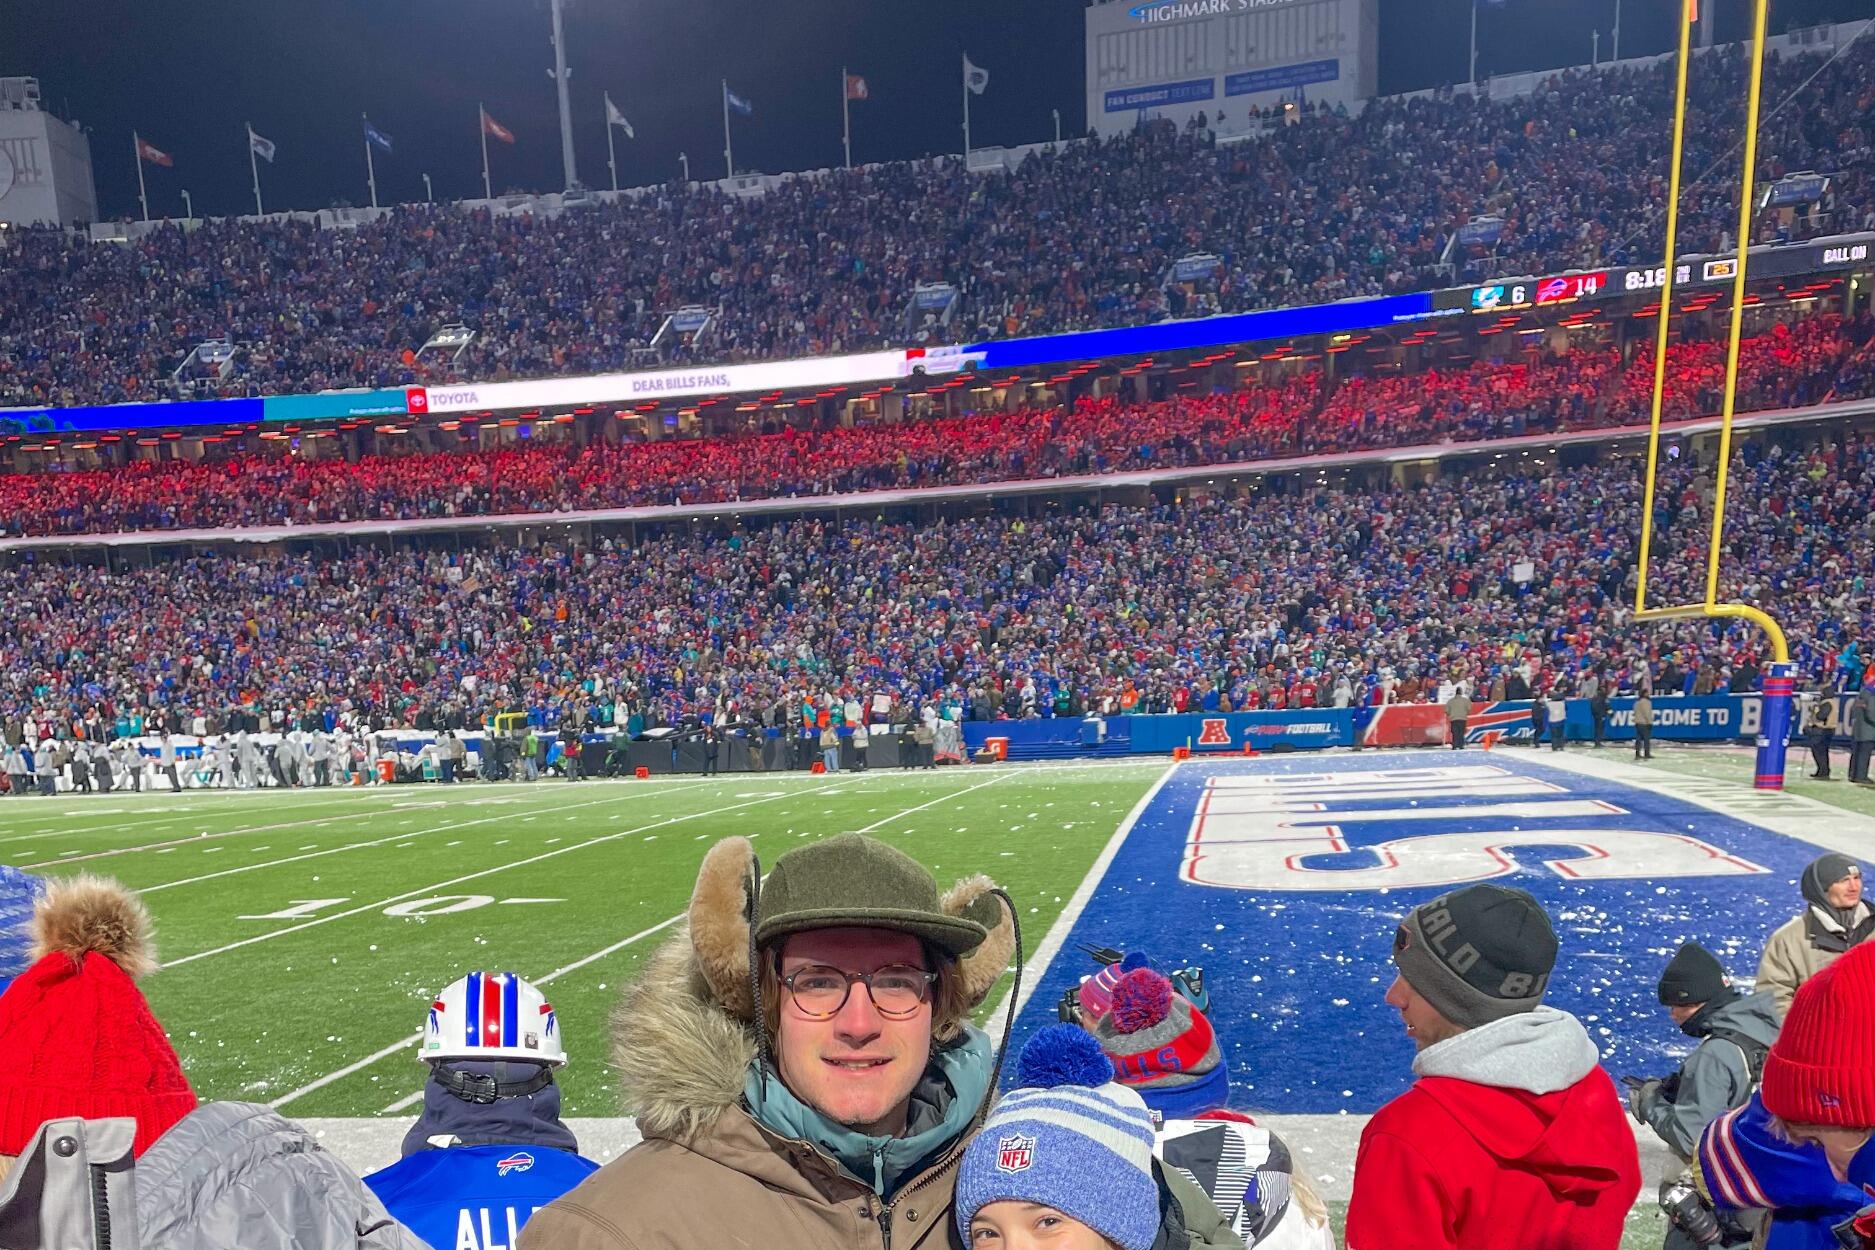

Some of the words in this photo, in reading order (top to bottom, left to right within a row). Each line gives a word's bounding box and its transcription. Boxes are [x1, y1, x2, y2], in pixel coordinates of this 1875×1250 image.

[1140, 0, 1230, 23] HIGHMARK
[1851, 245, 1867, 260] ON
[1713, 264, 1730, 275] 25
[1512, 286, 1525, 304] 6
[1574, 277, 1597, 297] 14
[632, 378, 664, 392] DEAR
[666, 376, 696, 390] BILLS
[697, 374, 731, 388] FANS,
[431, 392, 479, 406] TOYOTA
[1611, 708, 1701, 726] WECOME
[1706, 708, 1729, 725] TO
[1286, 723, 1332, 735] FOOTBALL
[1001, 1150, 1028, 1168] NFL
